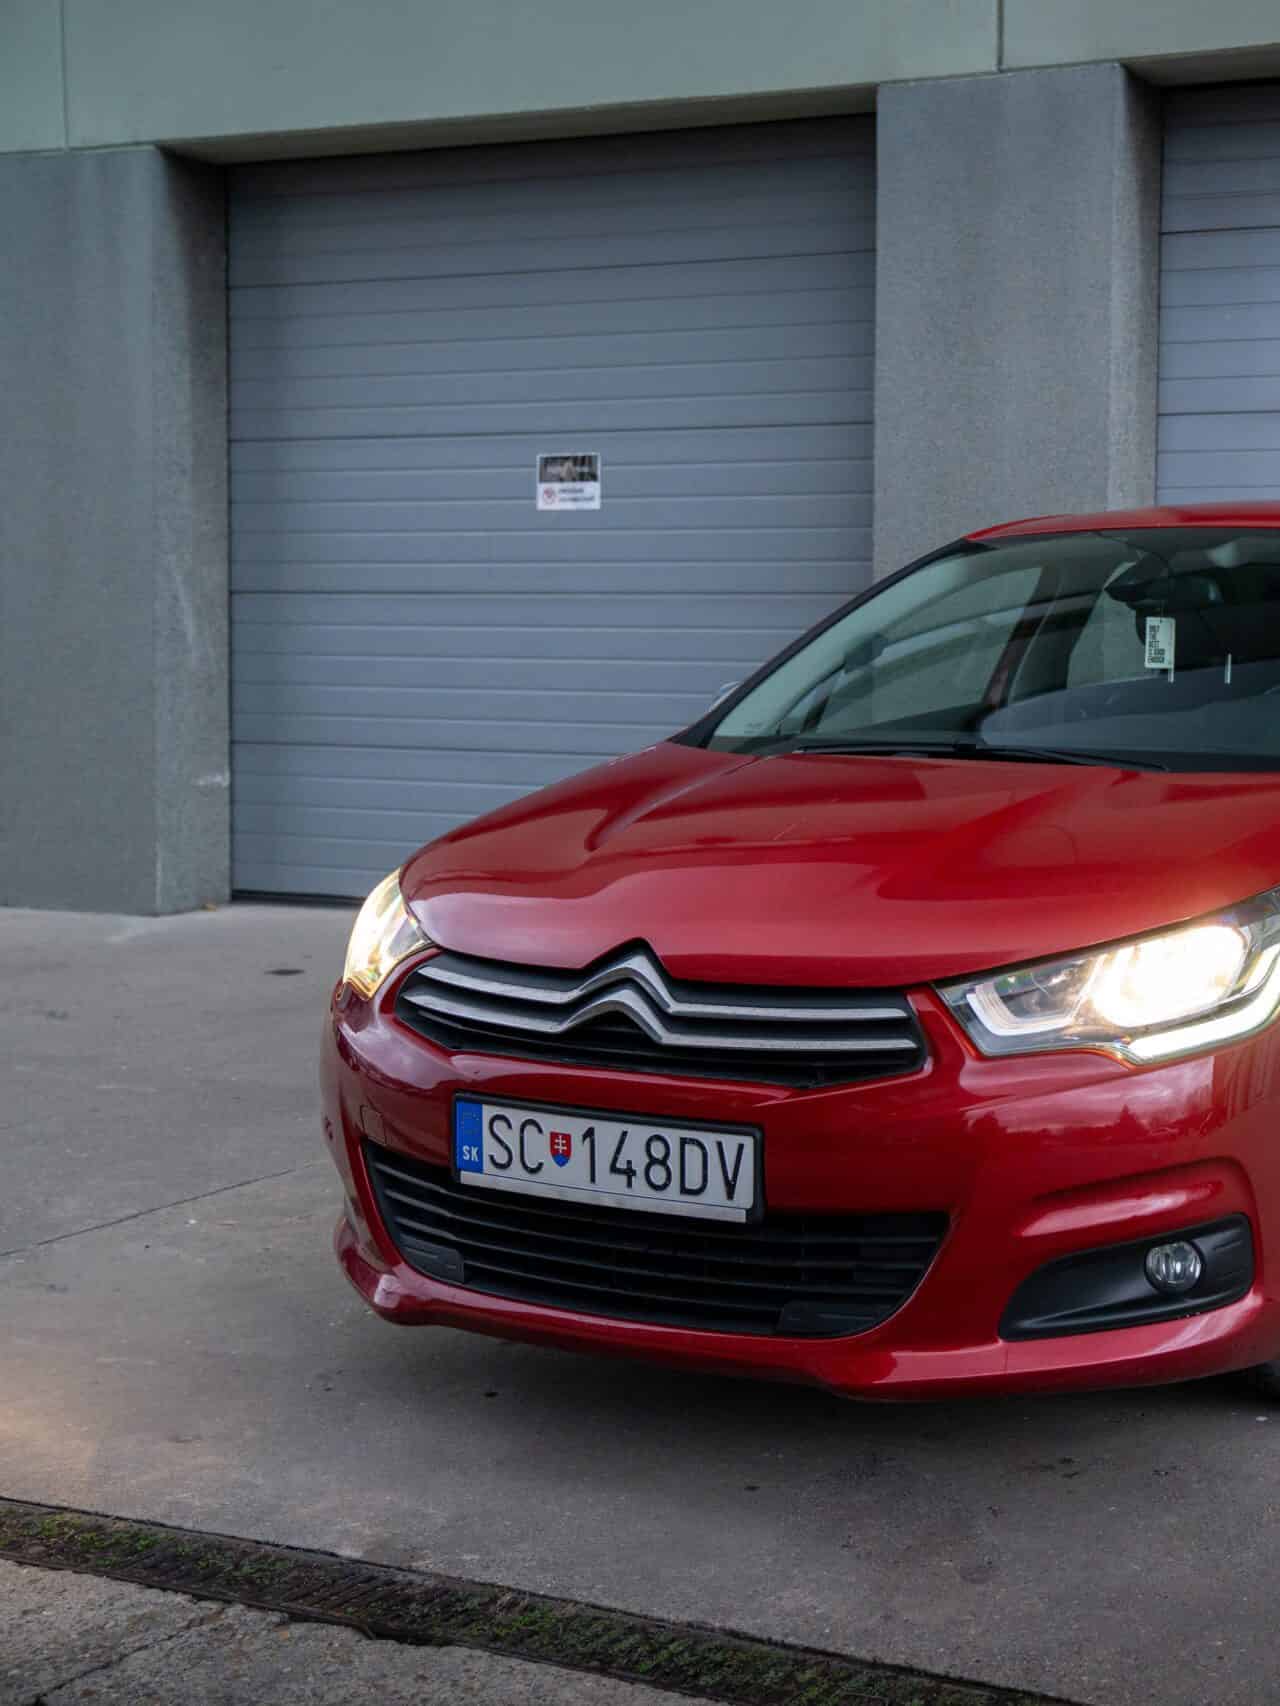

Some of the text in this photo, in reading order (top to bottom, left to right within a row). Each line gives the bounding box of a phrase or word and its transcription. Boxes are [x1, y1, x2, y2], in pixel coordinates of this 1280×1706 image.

[462, 1145, 479, 1162] SK
[488, 1113, 745, 1201] SC 148DV
